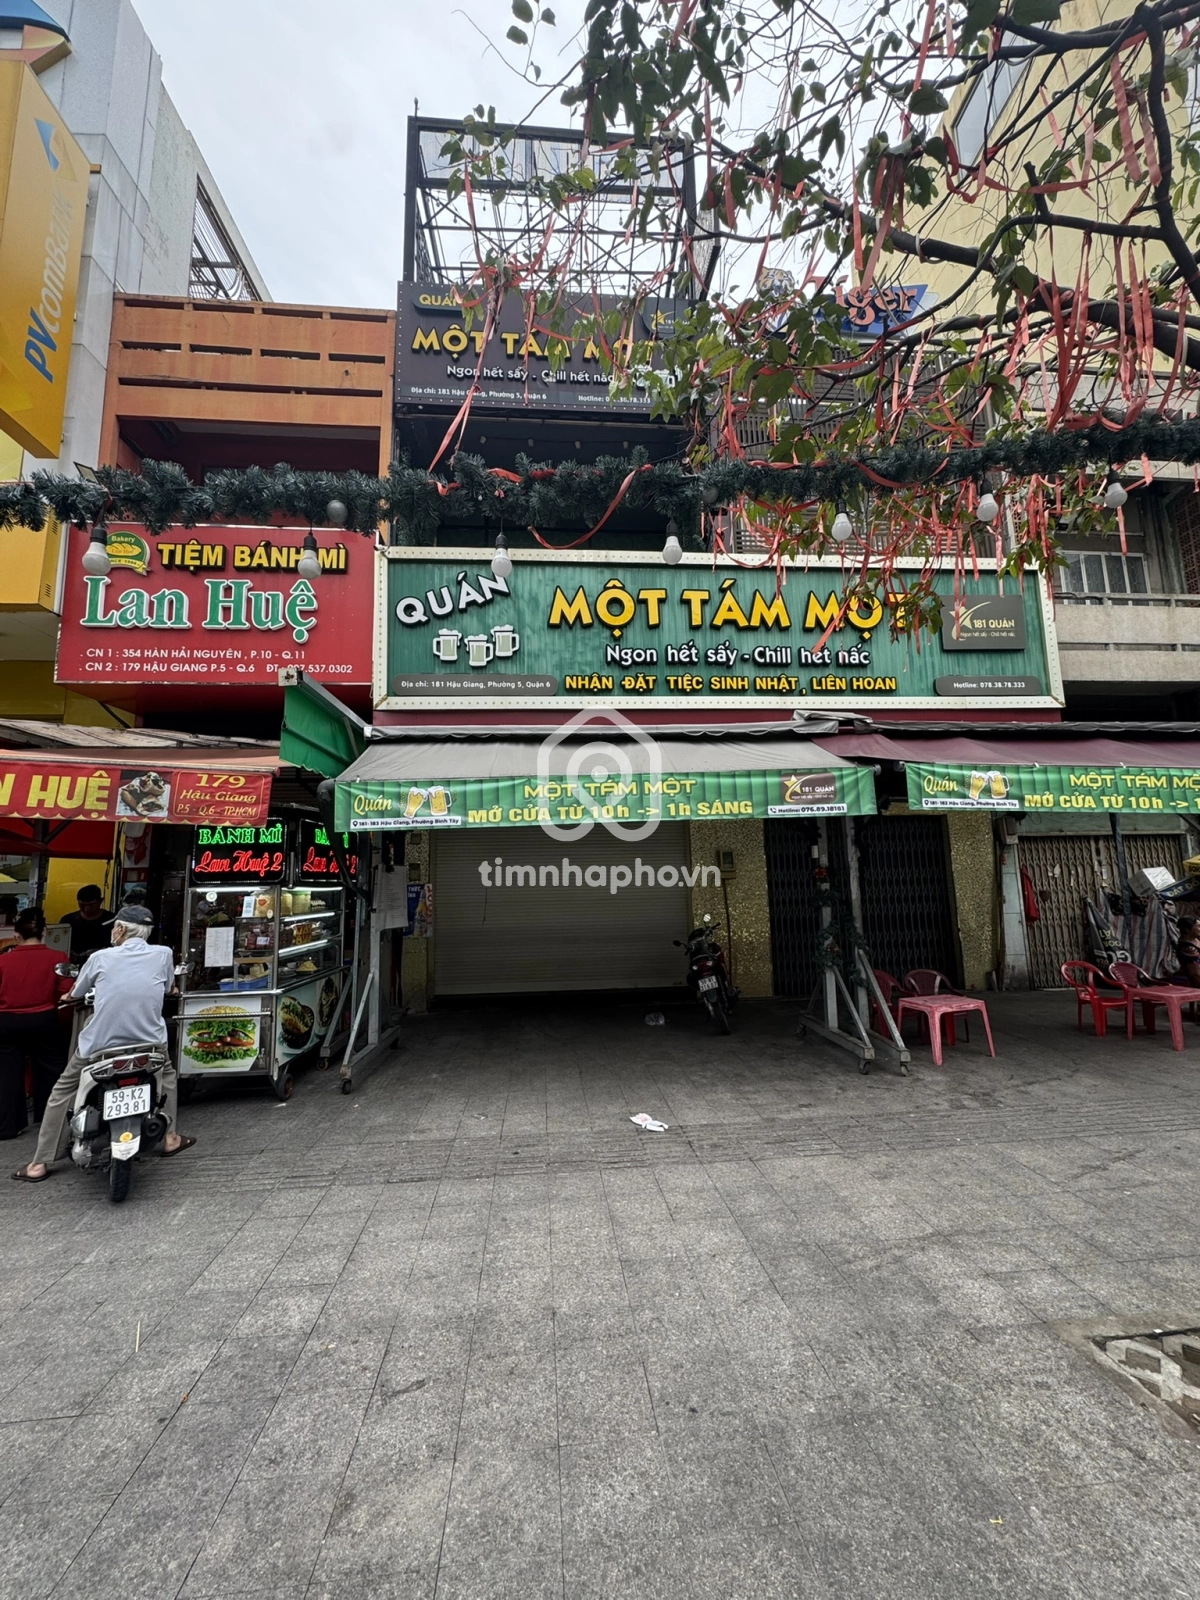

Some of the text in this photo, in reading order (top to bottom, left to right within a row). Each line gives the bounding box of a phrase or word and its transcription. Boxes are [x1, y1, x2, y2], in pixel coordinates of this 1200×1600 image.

[412, 324, 485, 359] MỘT
[570, 370, 590, 382] hết
[111, 535, 136, 543] Bakery
[157, 540, 347, 571] TIỆM BÁNH MÌ
[396, 571, 511, 624] QUÁN
[80, 575, 318, 644] Lan Huệ
[549, 579, 667, 637] MỘT
[681, 578, 790, 628] TÁM
[973, 617, 1015, 628] 181 QUÁN
[86, 648, 104, 657] CN
[122, 649, 141, 658] 354
[143, 645, 167, 658] HÀN
[171, 645, 190, 659] HẢI
[193, 647, 242, 659] NGUYÊN
[250, 650, 272, 659] P.10
[281, 650, 305, 660] Q.11
[606, 644, 657, 665] Ngon
[667, 640, 698, 662] hết
[753, 645, 791, 663] Chill
[838, 643, 870, 664] nấc
[85, 662, 102, 671] CN
[105, 662, 112, 671] 2
[122, 663, 140, 671] 179
[143, 661, 167, 673] HẬU
[170, 663, 208, 672] GIANG
[210, 664, 226, 672] P.5
[236, 664, 255, 673] Q.6
[266, 664, 279, 673] ĐT
[446, 681, 461, 689] Hậu
[463, 681, 486, 689] Giang,
[487, 681, 516, 689] Phường
[565, 673, 613, 691] NHẬN
[621, 672, 656, 692] ĐẶT
[666, 673, 703, 692] TIỆC
[710, 676, 748, 690] SINH
[812, 673, 847, 690] LIÊN
[852, 677, 896, 691] HOAN
[194, 773, 246, 788] 179
[524, 777, 696, 801] MỘT TÁM MỘT
[814, 785, 835, 793] QUÁN
[923, 774, 958, 795] Quán
[1069, 771, 1115, 789] MỘT
[1121, 772, 1168, 789] TÁM
[26, 770, 112, 819] HUỆ
[180, 789, 257, 803] Hậu Giang
[353, 793, 392, 815] Quán
[1024, 790, 1055, 807] MỞ
[1058, 792, 1097, 808] CỬA
[1100, 791, 1124, 809] TỪ
[1130, 796, 1163, 809] 10h
[177, 804, 190, 814] P.5
[198, 804, 215, 816] Q.6
[224, 805, 256, 816] TP.HCM
[468, 805, 502, 823] MỞ
[508, 804, 551, 822] CỬA
[557, 804, 586, 820] TỪ
[591, 804, 629, 820] 10h
[666, 803, 690, 817] 1h
[697, 799, 753, 816] SÁNG
[195, 850, 283, 877] Lan Huệ 2
[112, 1088, 144, 1103] 59-K2
[107, 1099, 146, 1118] 293.81
